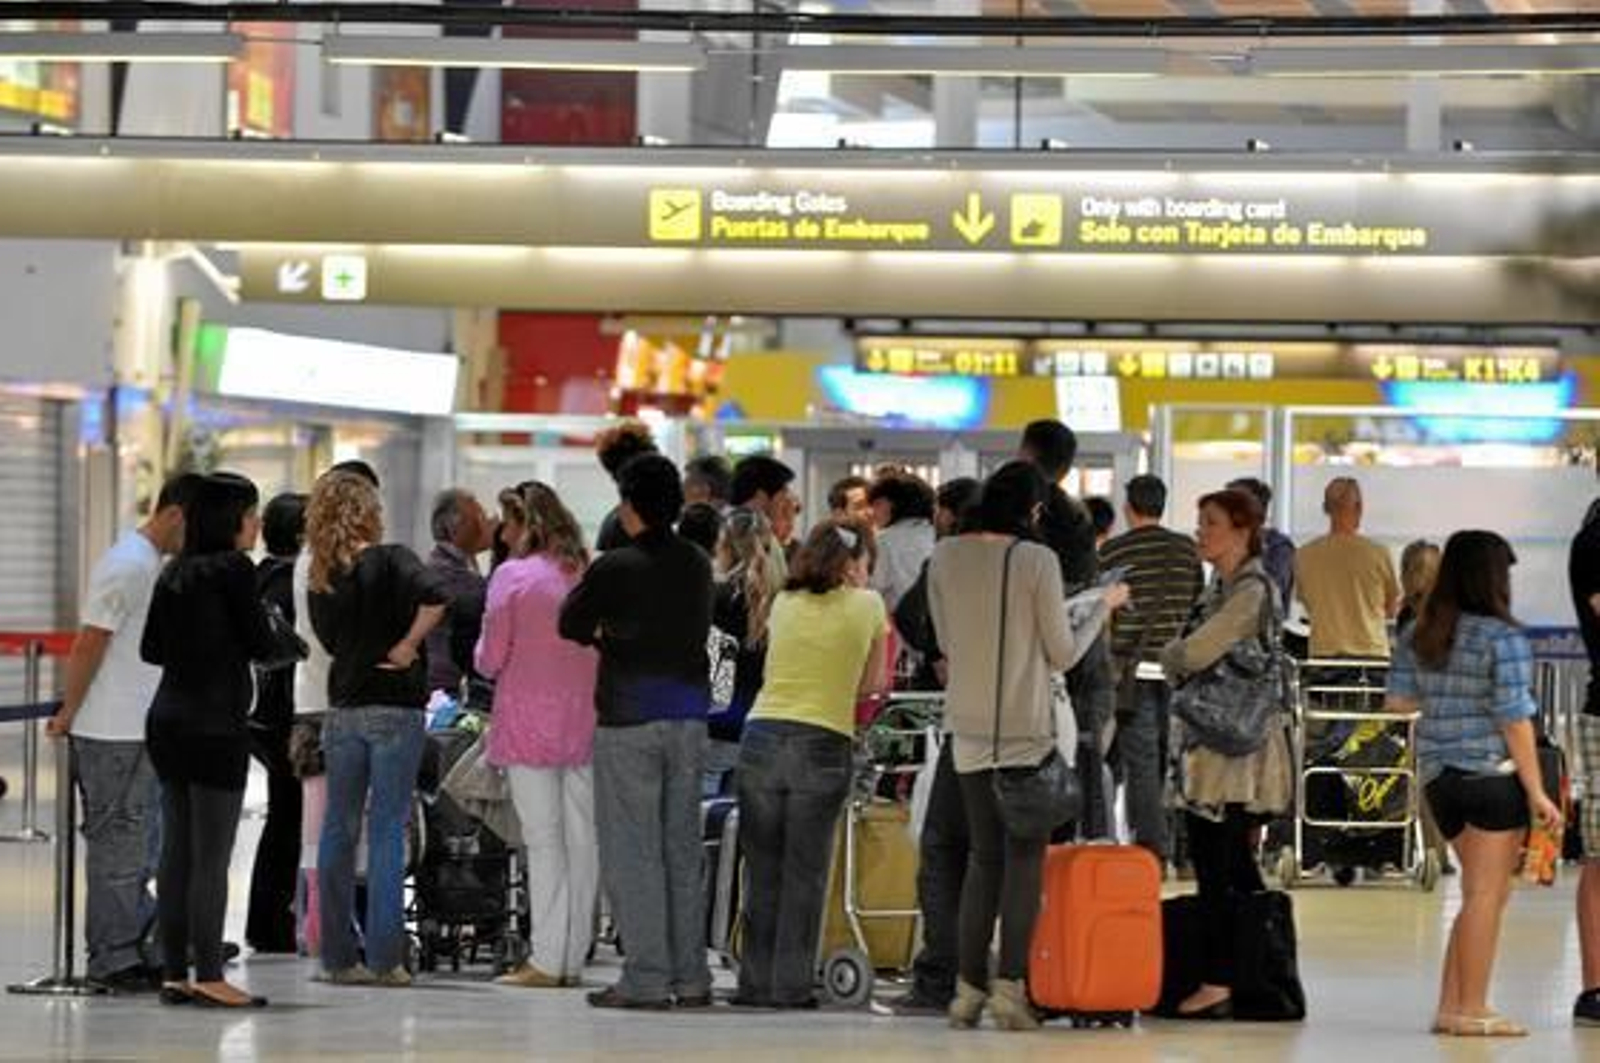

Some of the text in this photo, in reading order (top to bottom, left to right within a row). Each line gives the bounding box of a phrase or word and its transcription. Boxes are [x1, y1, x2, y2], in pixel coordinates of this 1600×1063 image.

[711, 190, 847, 215] Boarding Gates
[1081, 198, 1286, 221] Only with boarding card
[711, 216, 929, 243] Puertas de Embarque
[1136, 224, 1180, 243] con
[1184, 220, 1267, 249] Tarjeta
[1272, 221, 1300, 246] de
[1307, 221, 1427, 251] Embarque
